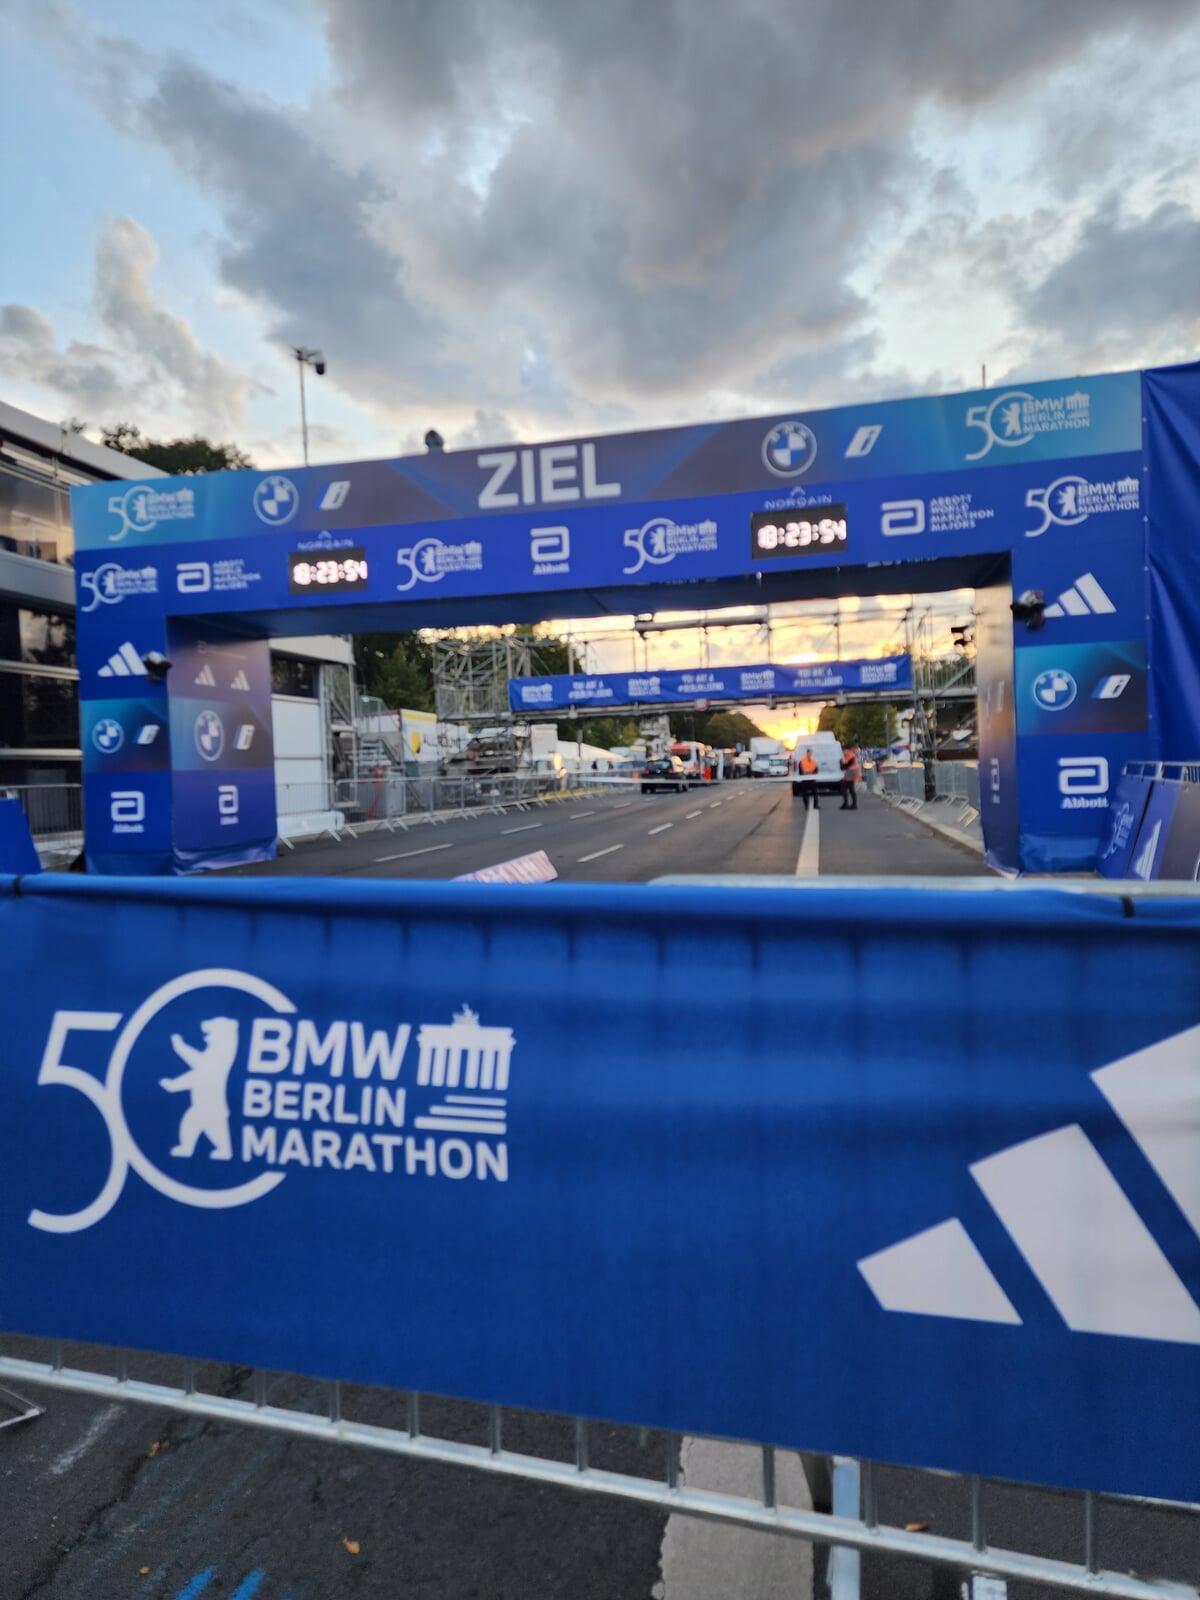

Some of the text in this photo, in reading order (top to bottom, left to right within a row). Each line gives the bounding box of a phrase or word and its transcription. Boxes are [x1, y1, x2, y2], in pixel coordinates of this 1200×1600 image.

[1023, 398, 1064, 414] BMW
[1023, 410, 1066, 424] BERLIN
[1023, 418, 1090, 433] MARATHON
[477, 443, 621, 509] ZIEL
[1079, 481, 1115, 496] BMW
[1079, 493, 1117, 506] BERLIN
[1079, 500, 1139, 514] MARATHON
[1061, 796, 1109, 809] Abbott
[247, 1018, 411, 1080] BMW
[28, 968, 297, 1233] 50
[243, 1079, 406, 1127] BERLIN
[242, 1125, 508, 1182] MARATHON
